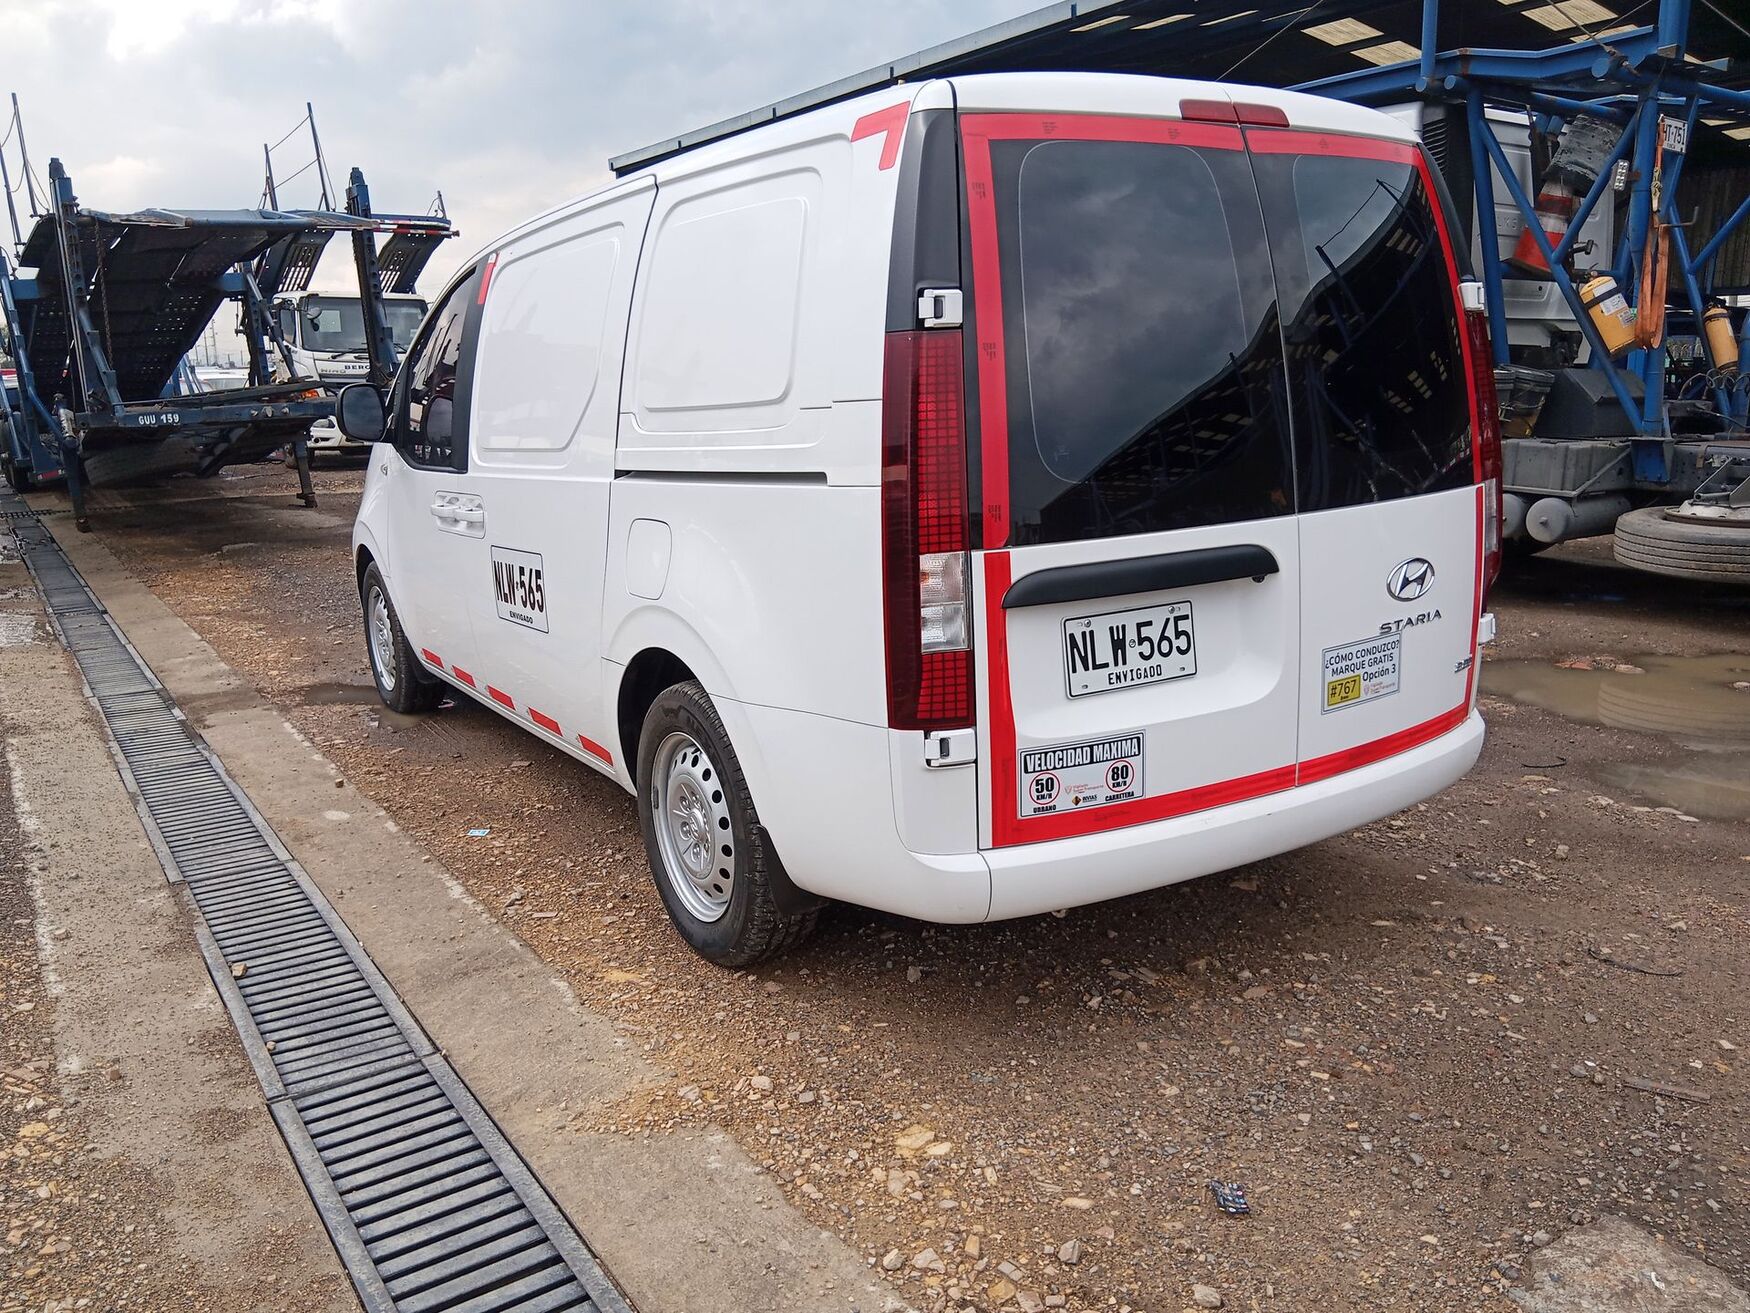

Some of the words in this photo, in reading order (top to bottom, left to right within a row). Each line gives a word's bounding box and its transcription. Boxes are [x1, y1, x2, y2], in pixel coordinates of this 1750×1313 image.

[138, 414, 156, 425] GUU
[160, 413, 179, 424] 159
[1379, 609, 1442, 636] STARIA
[1325, 651, 1354, 670] ¿CÓMO
[1355, 639, 1400, 661] CONDUZCO?
[1331, 659, 1366, 677] MARQUE
[1367, 652, 1394, 669] GRATIS
[1107, 663, 1162, 685] ENVIGADO
[1362, 667, 1390, 683] Opción
[1391, 663, 1397, 675] 3
[1330, 679, 1357, 699] #767
[1025, 746, 1091, 773] VELOCIDAD
[1093, 737, 1139, 762] MAXIMA
[1111, 764, 1129, 782] 80
[1035, 777, 1055, 794] 50
[1105, 791, 1135, 802] CARRETERA
[1033, 804, 1057, 813] URBANO
